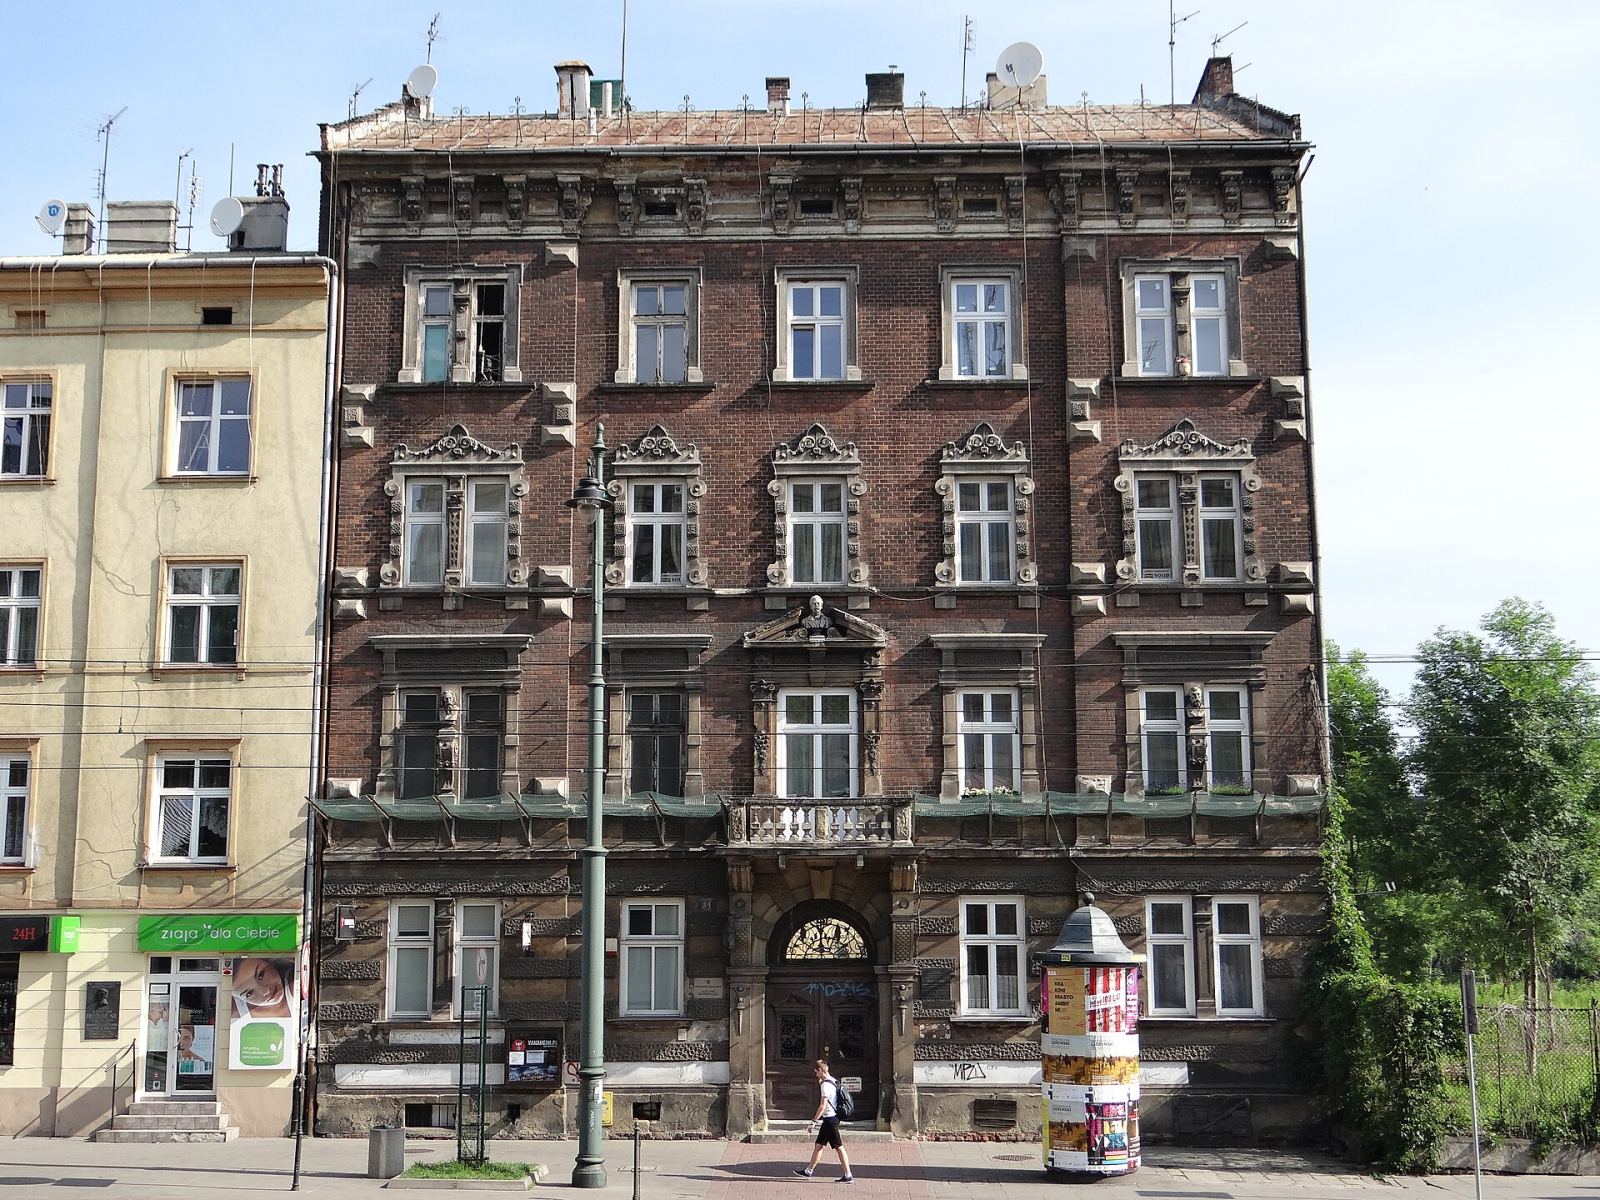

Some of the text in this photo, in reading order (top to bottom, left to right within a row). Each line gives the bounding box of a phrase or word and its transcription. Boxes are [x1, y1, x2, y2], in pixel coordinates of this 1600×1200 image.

[12, 927, 36, 940] 24H
[161, 927, 280, 942] ziaja dla Ciebie
